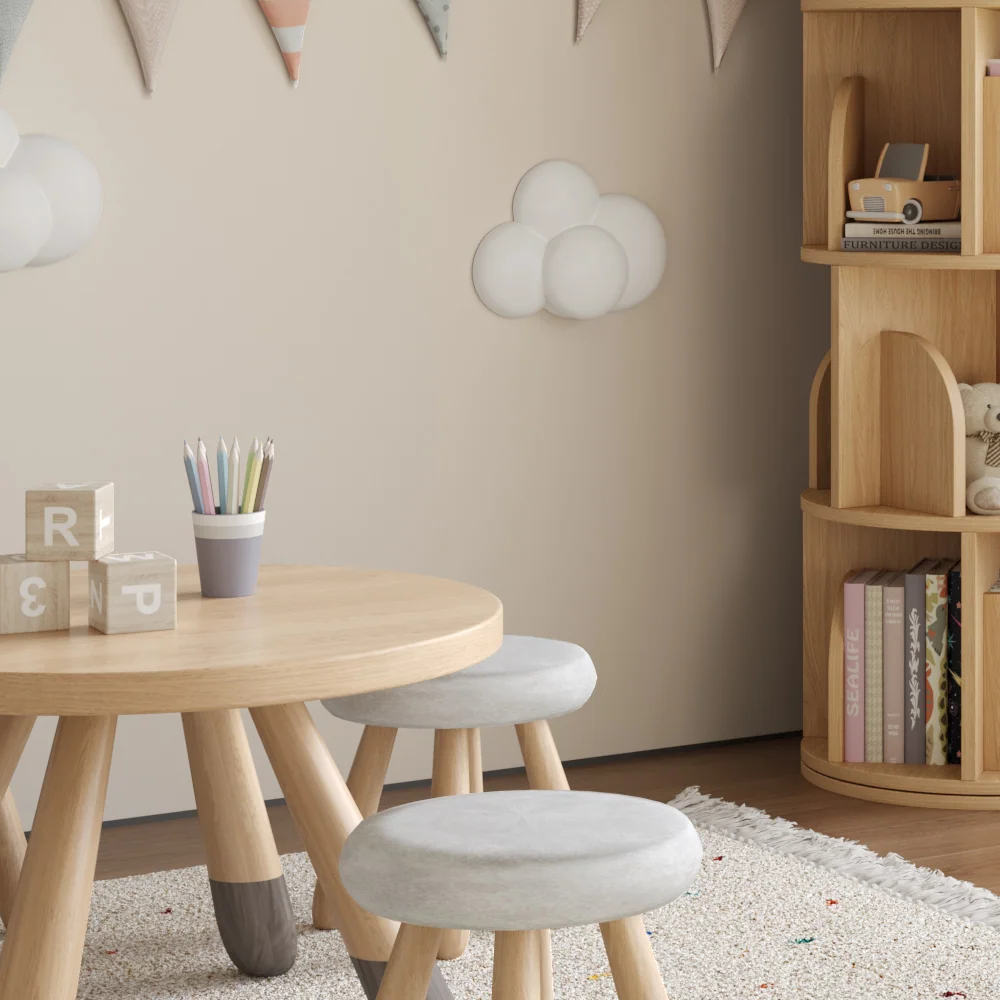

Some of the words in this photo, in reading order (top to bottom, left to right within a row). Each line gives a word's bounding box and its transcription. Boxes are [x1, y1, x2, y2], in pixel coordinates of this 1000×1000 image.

[844, 240, 917, 250] FURNITURE
[921, 240, 961, 250] DESIG
[44, 506, 79, 547] R
[122, 583, 161, 615] P
[846, 628, 860, 717] SEALIFE
